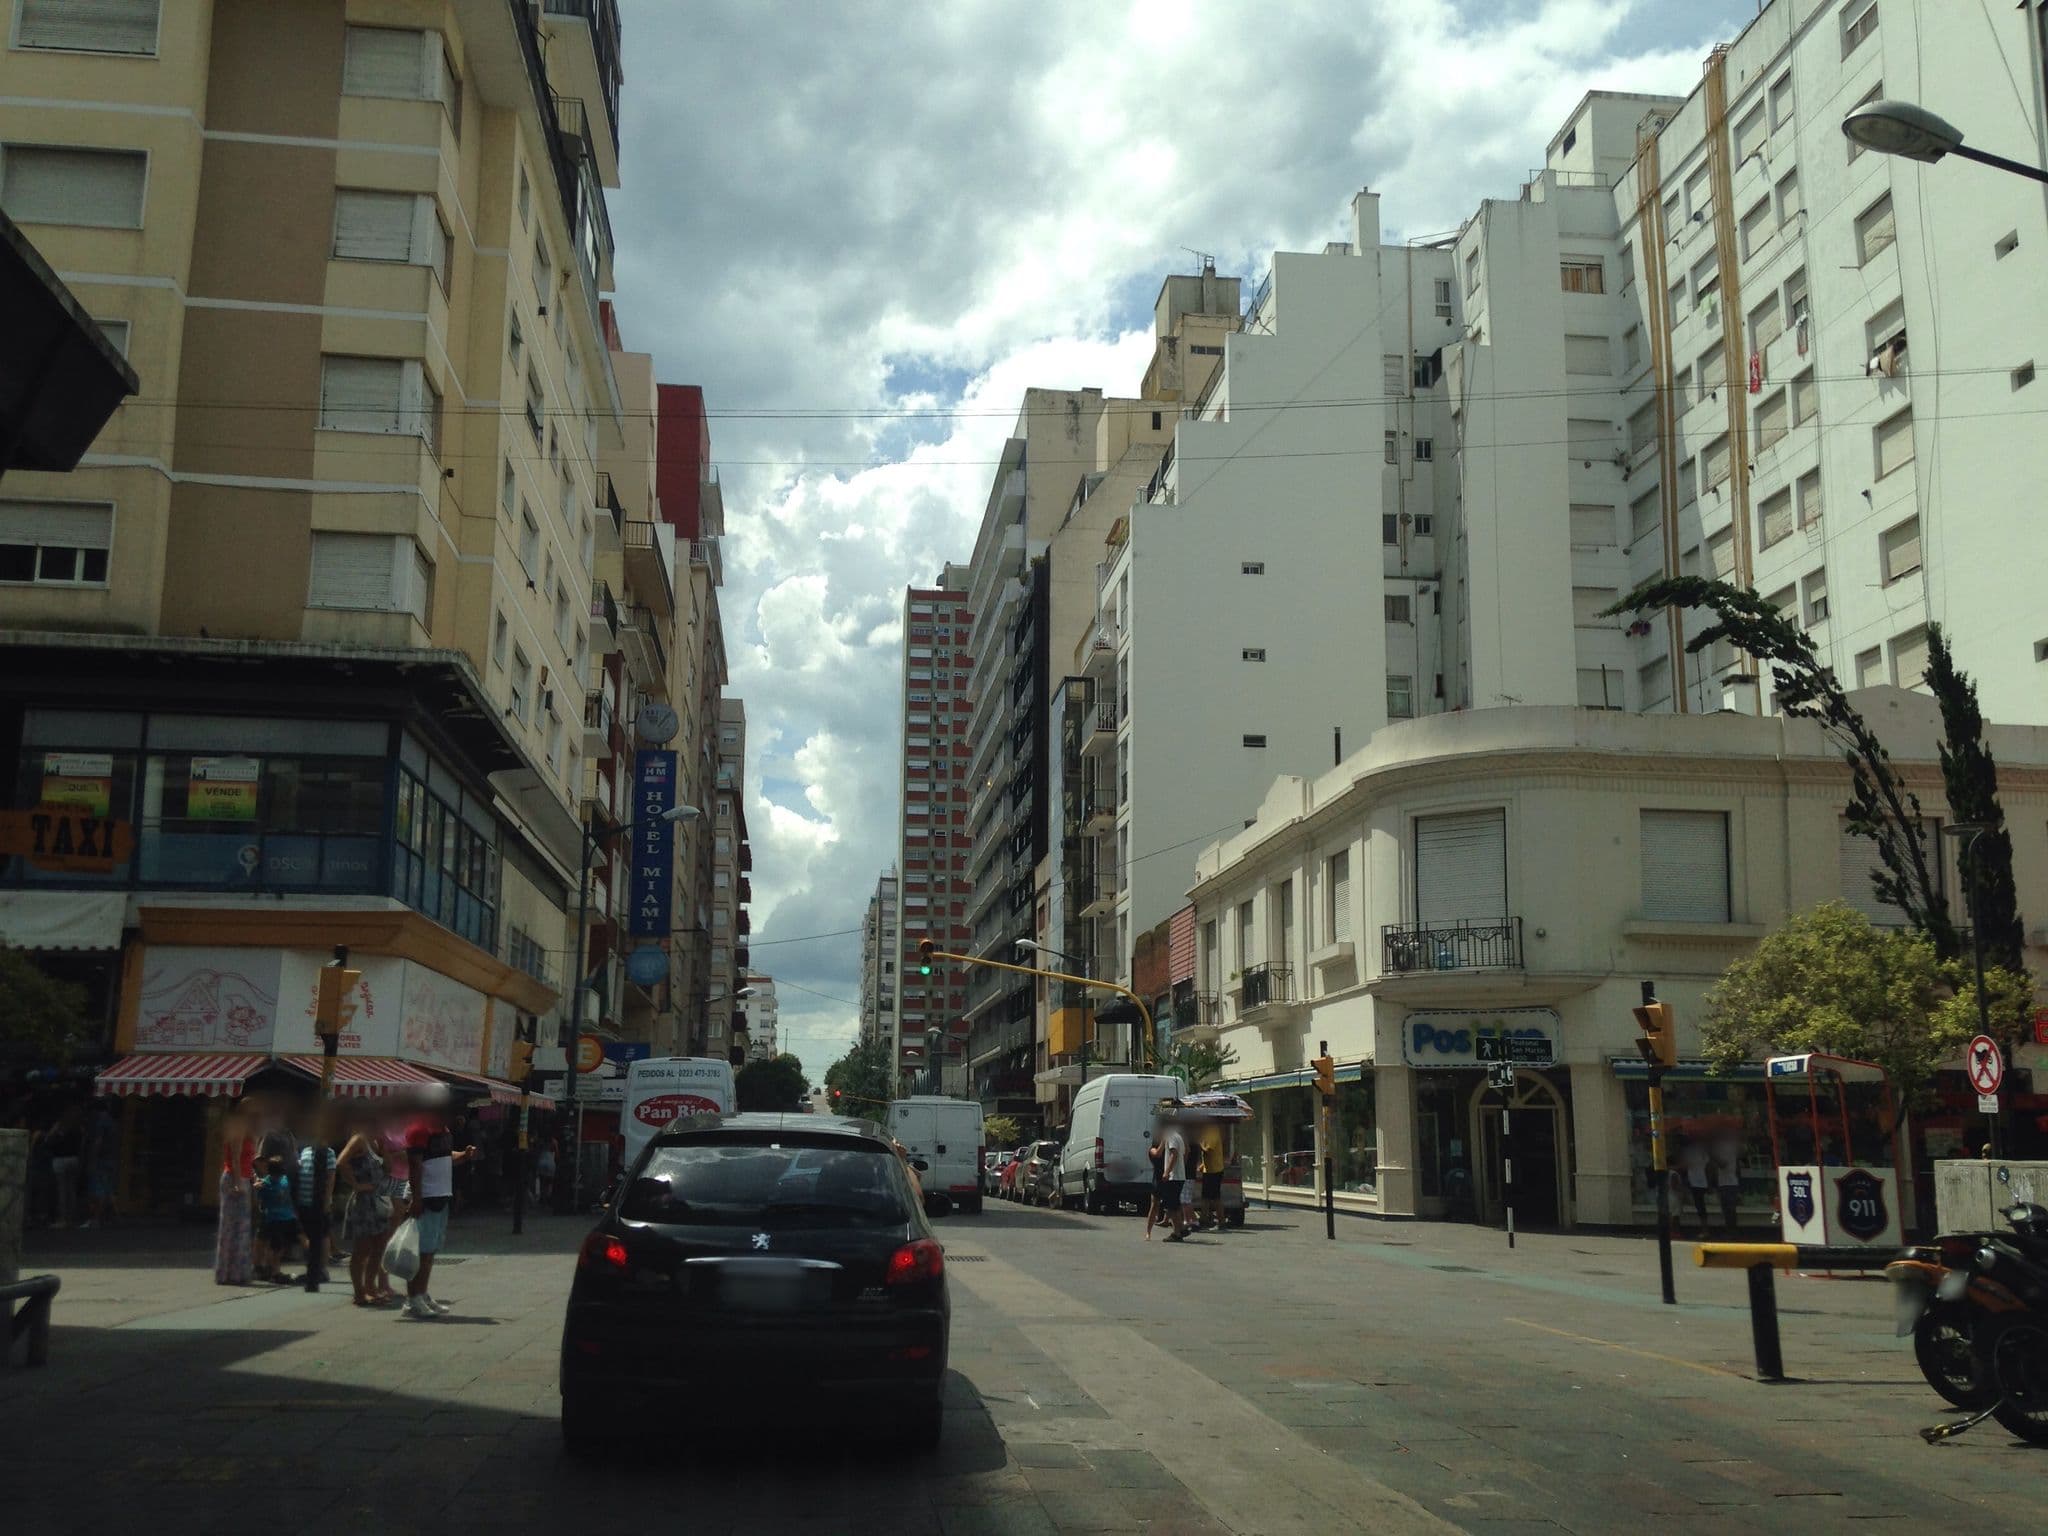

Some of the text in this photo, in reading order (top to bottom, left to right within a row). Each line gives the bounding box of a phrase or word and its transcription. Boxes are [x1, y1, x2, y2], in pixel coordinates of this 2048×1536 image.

[646, 767, 668, 777] HM
[205, 787, 241, 796] VENDE
[32, 815, 113, 857] TAXI
[640, 791, 664, 930] HOTEL MIAMI
[577, 1044, 592, 1064] E
[638, 1069, 665, 1079] PEDIDOS
[667, 1069, 675, 1078] AL
[679, 1069, 693, 1077] 0223
[639, 1105, 672, 1119] Pan
[1793, 1186, 1808, 1198] SOL
[1850, 1199, 1877, 1217] 911
